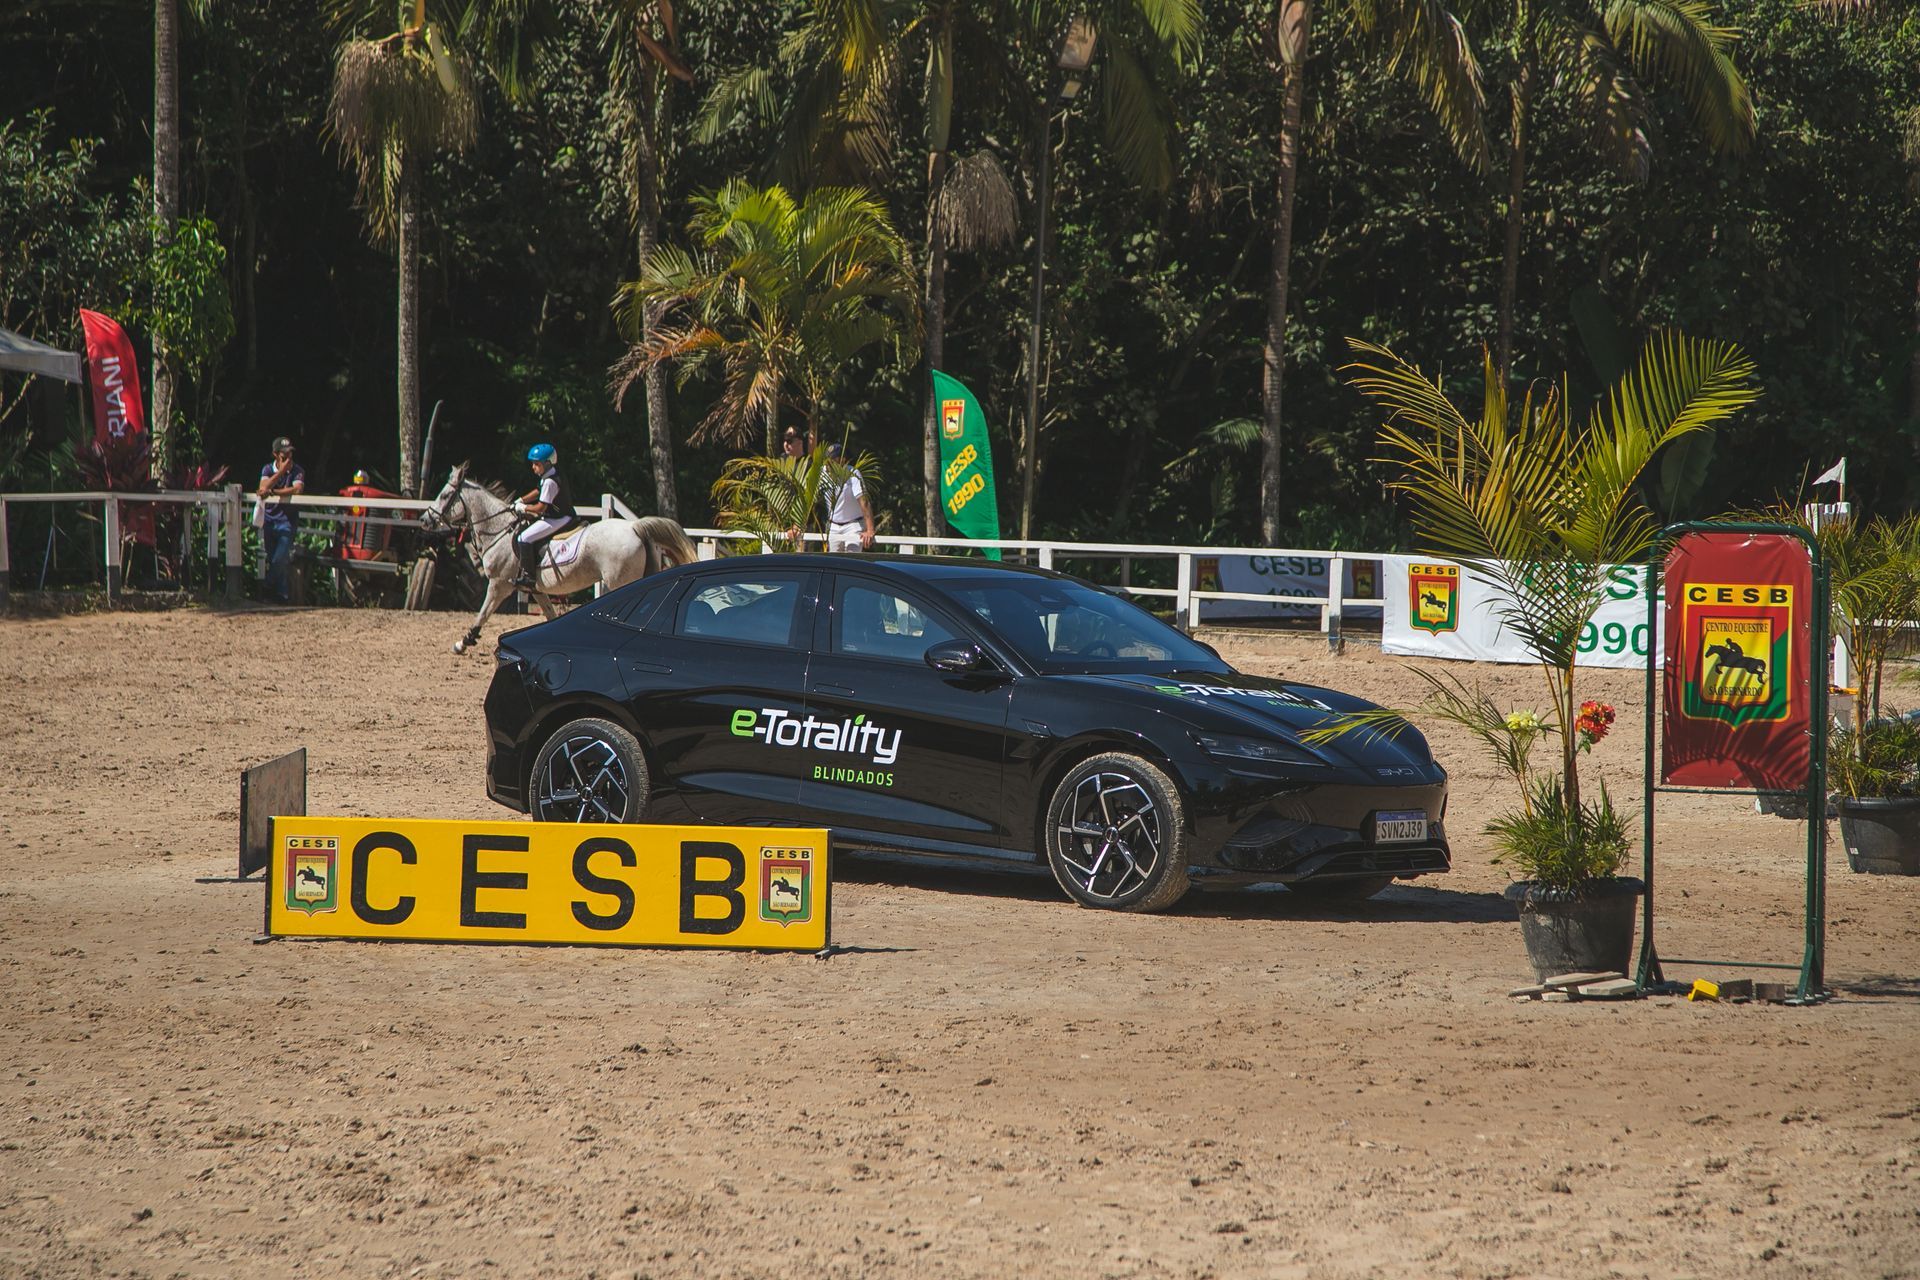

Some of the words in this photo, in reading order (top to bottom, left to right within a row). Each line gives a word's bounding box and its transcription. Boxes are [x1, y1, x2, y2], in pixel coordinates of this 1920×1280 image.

[945, 443, 978, 487] CESB
[947, 473, 985, 515] 1990
[1249, 555, 1325, 576] CESB
[1412, 566, 1456, 575] CESB
[1688, 587, 1789, 604] CESB
[1705, 621, 1733, 633] CENTRO
[1734, 621, 1768, 635] EQUESTRE
[1708, 684, 1723, 697] SÃO
[1724, 685, 1762, 697] BERNARDO
[730, 708, 902, 764] e-Totality
[813, 765, 894, 787] BLINDADOS
[1381, 821, 1423, 839] SVN2J39
[289, 839, 336, 848] CESB
[763, 849, 810, 859] CESB
[350, 830, 747, 935] CESB
